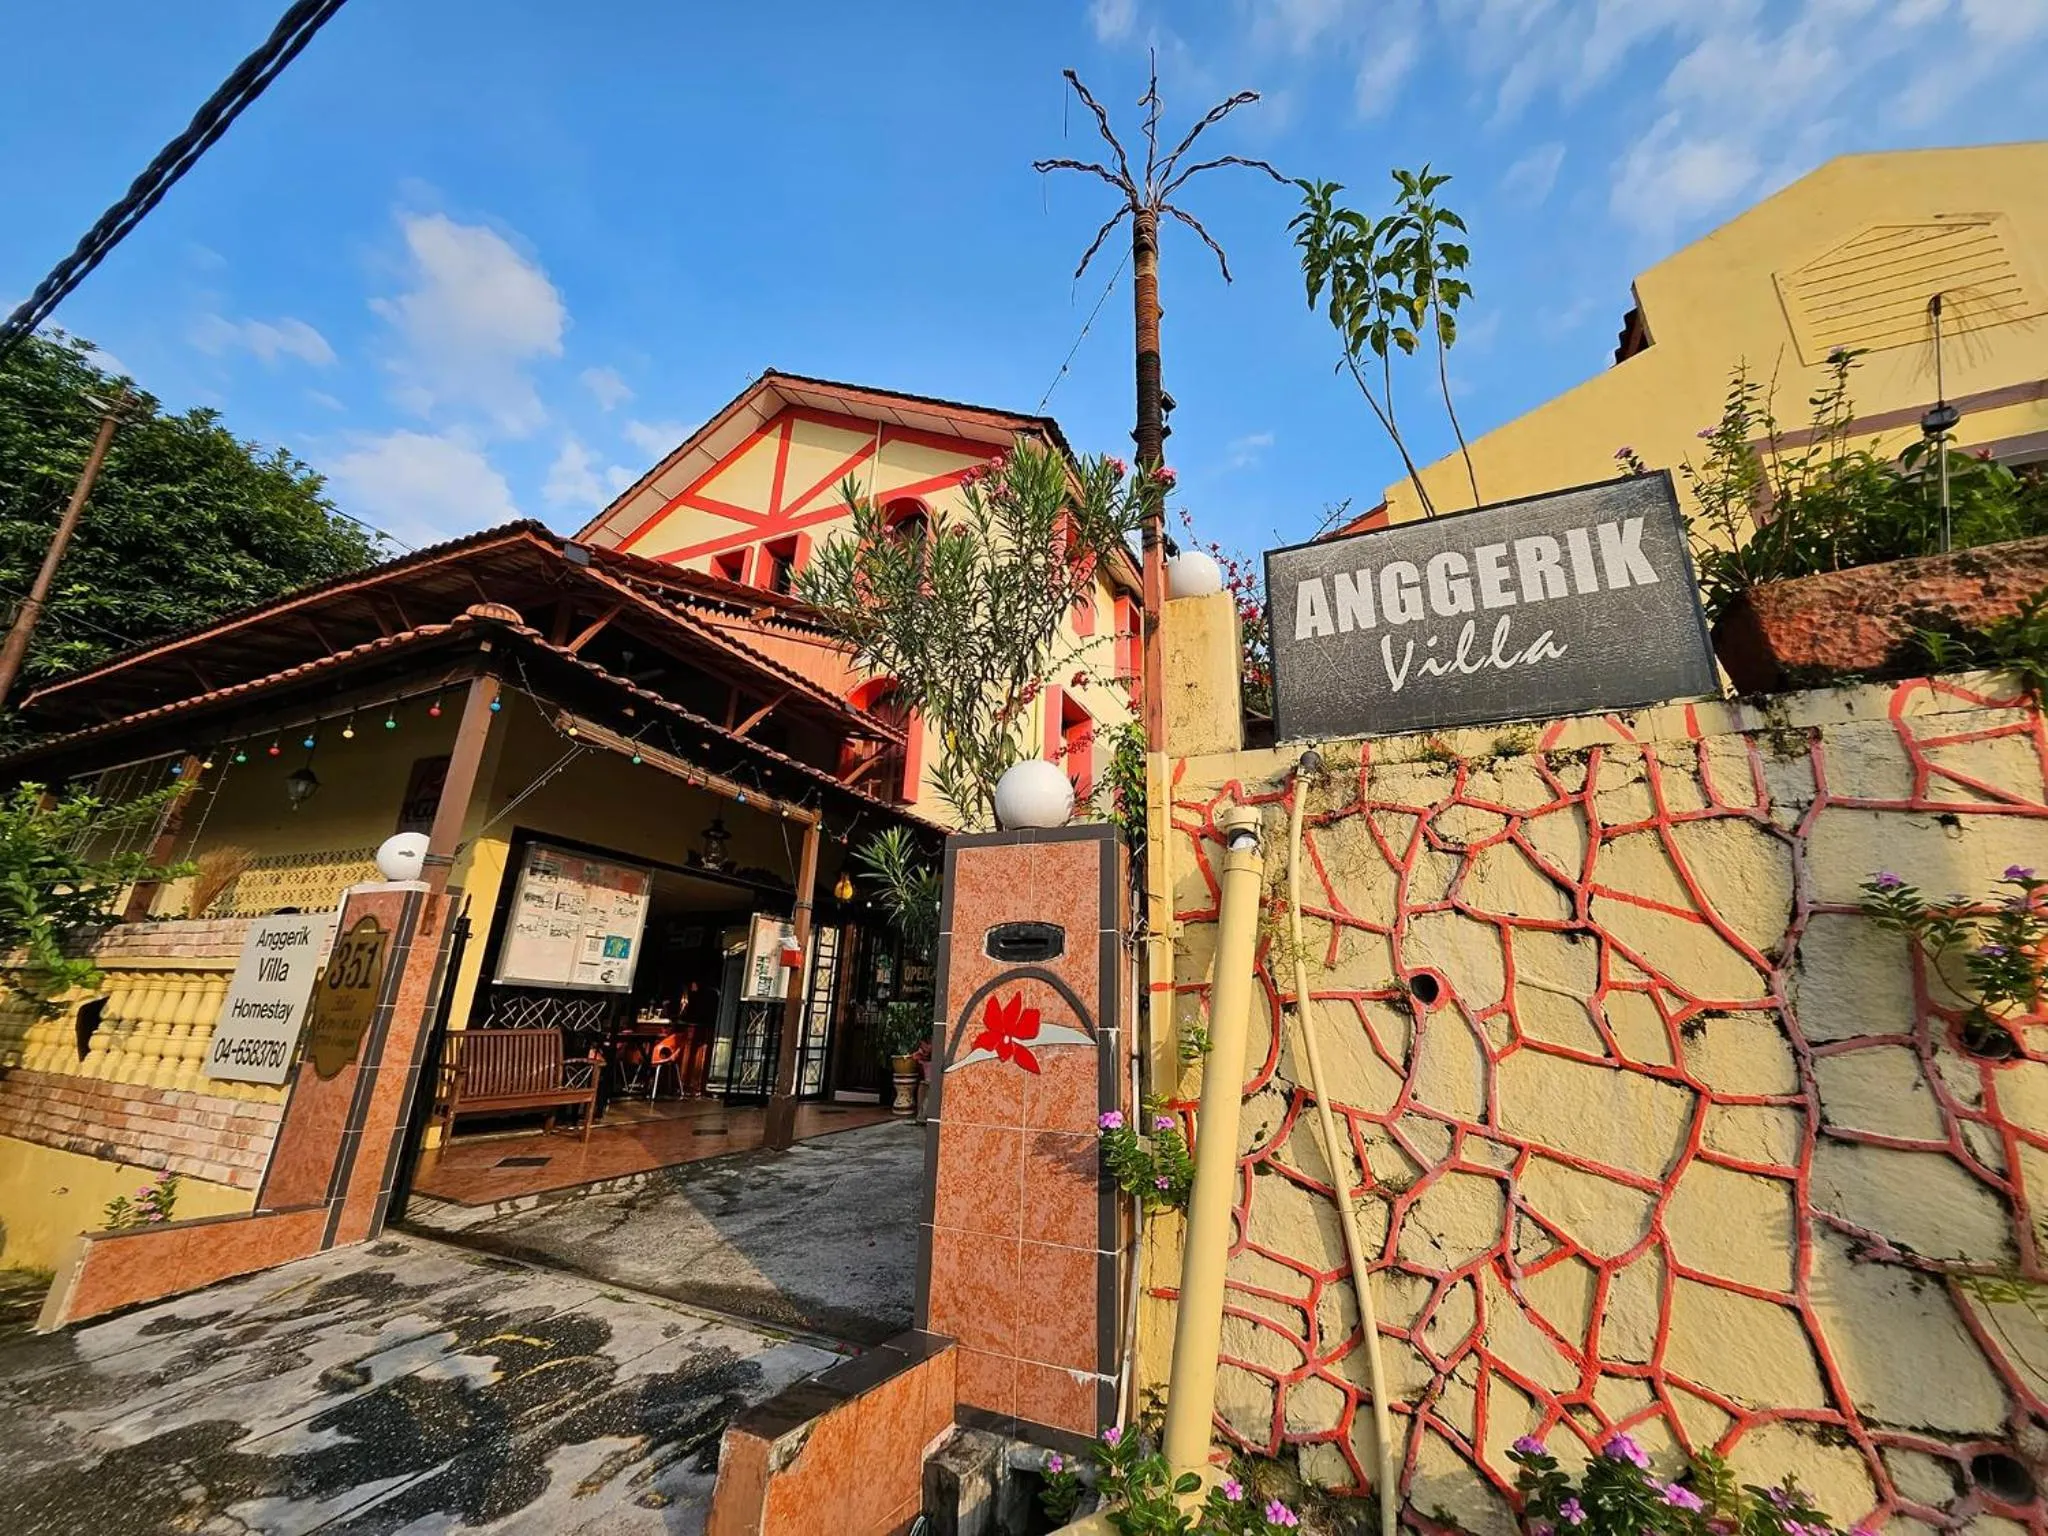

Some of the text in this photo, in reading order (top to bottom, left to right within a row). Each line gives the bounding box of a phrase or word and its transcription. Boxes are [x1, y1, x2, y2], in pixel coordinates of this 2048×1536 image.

[1294, 518, 1660, 641] ANGGERIK
[1381, 614, 1568, 692] Villa
[257, 926, 311, 951] Anggerik
[258, 958, 290, 982] Villa
[328, 941, 379, 989] 351
[232, 998, 295, 1025] Homestay
[213, 1038, 287, 1068] 04-6583760
